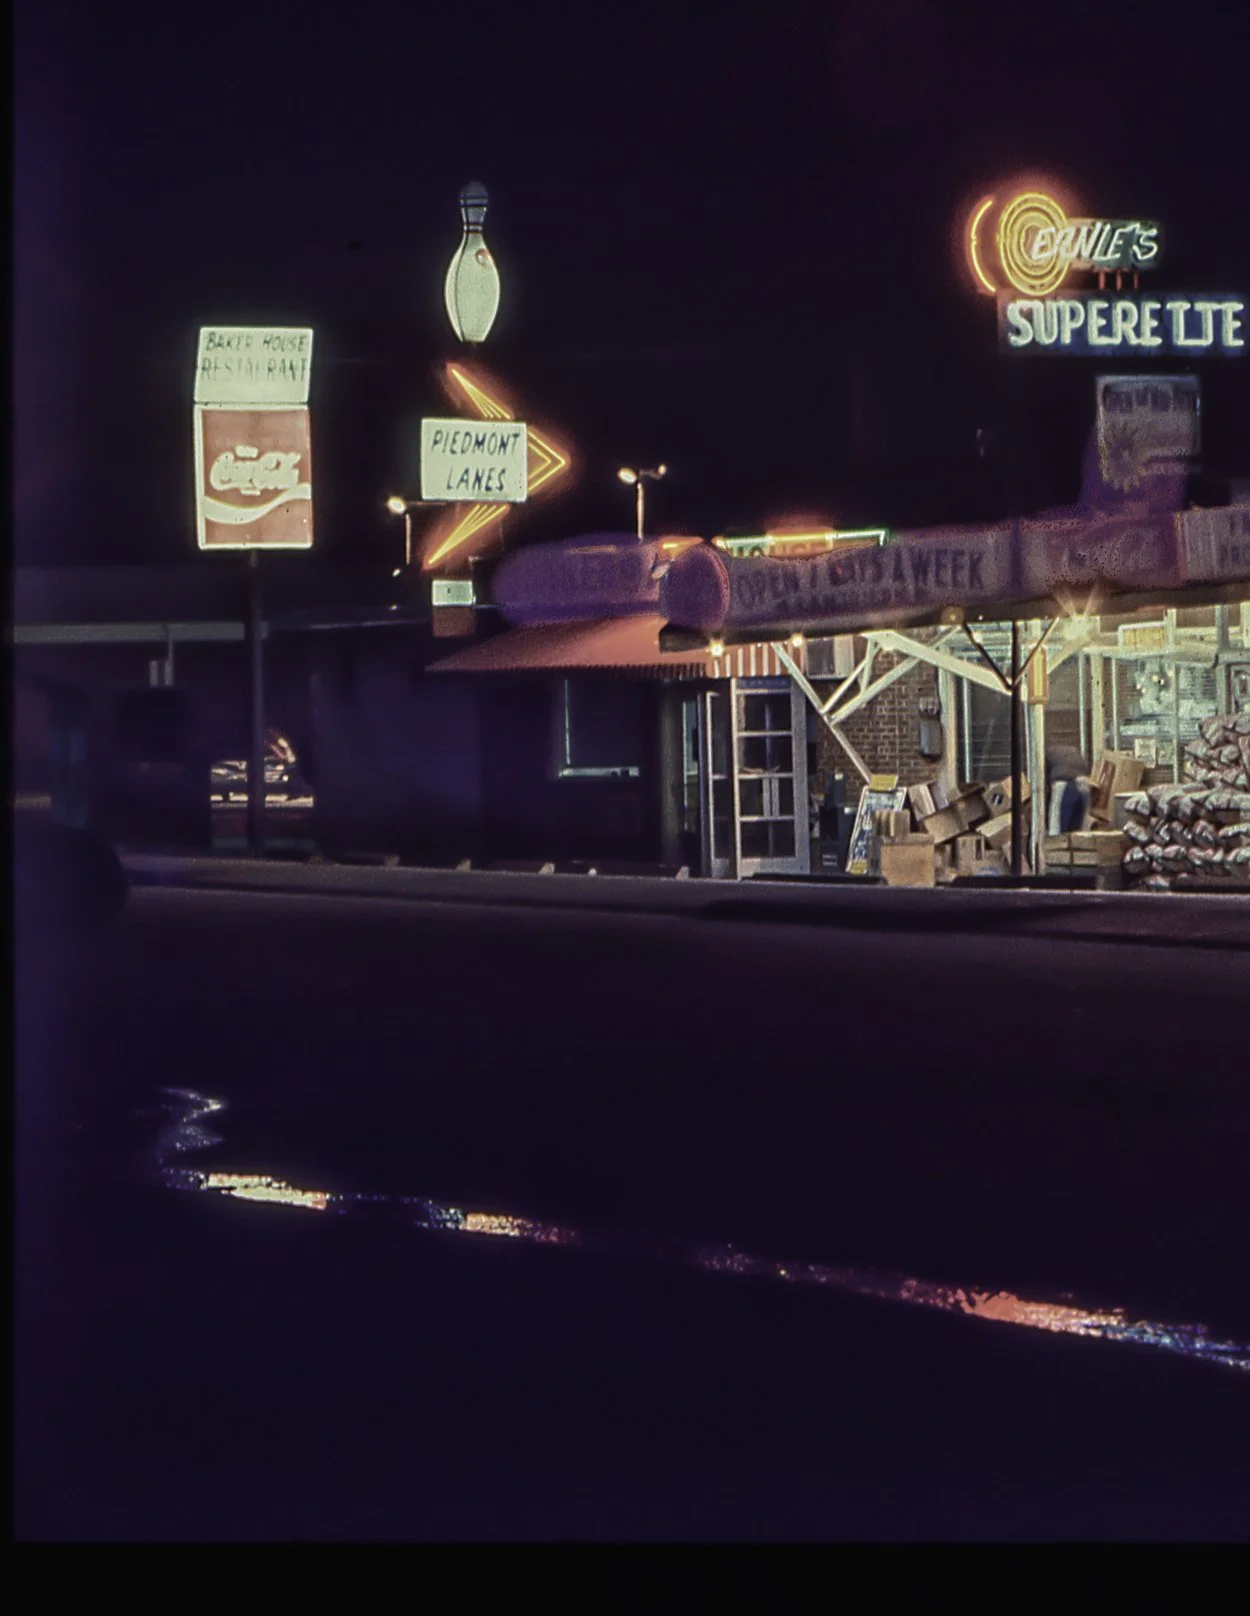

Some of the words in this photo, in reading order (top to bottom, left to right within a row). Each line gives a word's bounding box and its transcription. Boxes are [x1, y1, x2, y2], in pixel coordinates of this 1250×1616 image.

[1006, 299, 1245, 347] SUPERETTE
[263, 332, 308, 353] HOUSE
[430, 429, 520, 456] PIEDMONT
[446, 466, 506, 492] LANES
[911, 547, 984, 591] WEEK
